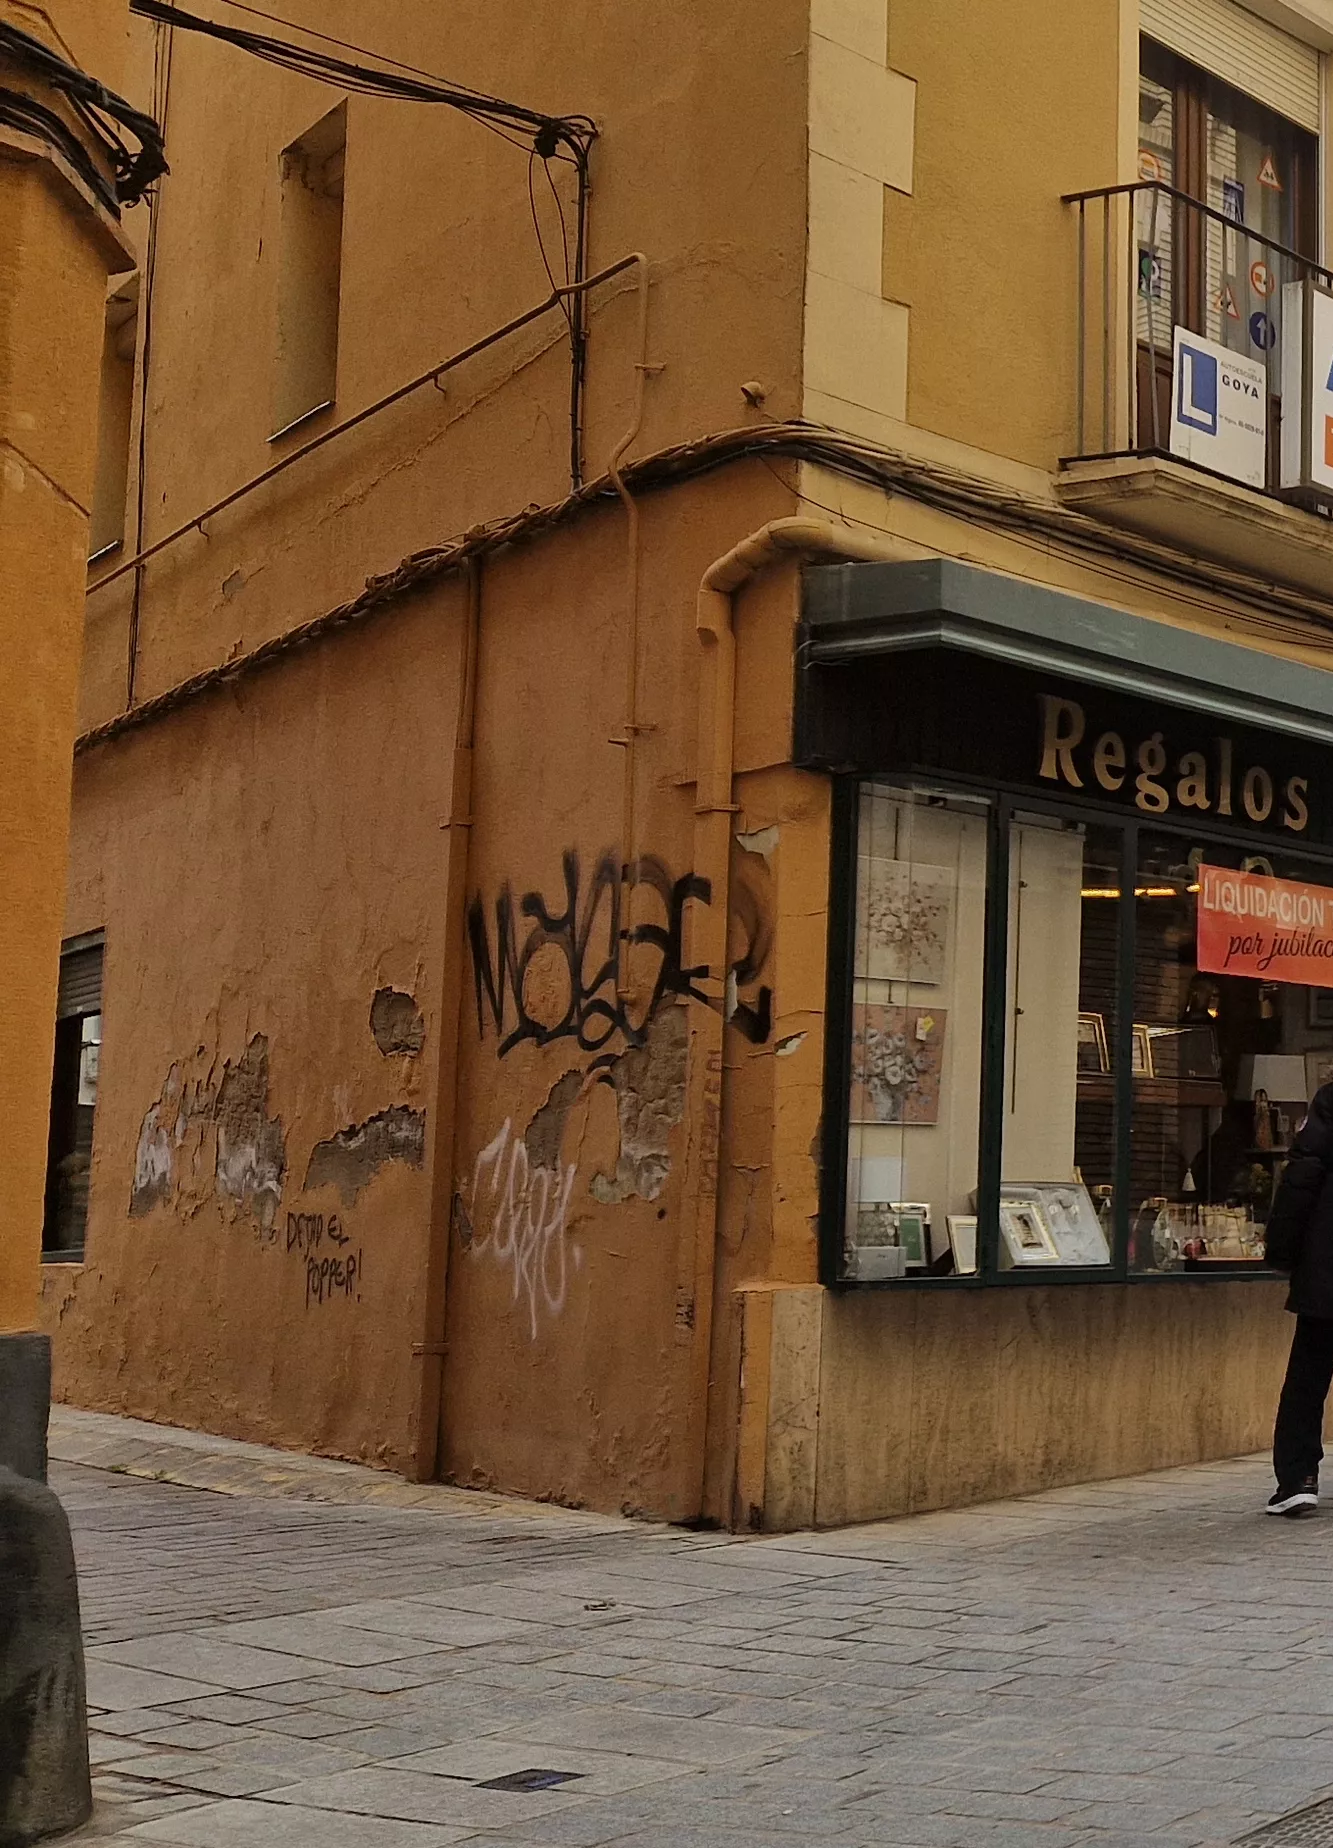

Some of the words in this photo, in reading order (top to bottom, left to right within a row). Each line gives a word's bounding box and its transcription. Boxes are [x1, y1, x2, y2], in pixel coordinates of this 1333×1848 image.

[1220, 361, 1263, 385] AUTOESCUELA
[1222, 374, 1260, 400] GOYA
[1037, 693, 1309, 832] Regalos
[1203, 876, 1325, 928] LIQUIDACIÓN
[1223, 932, 1265, 968] por
